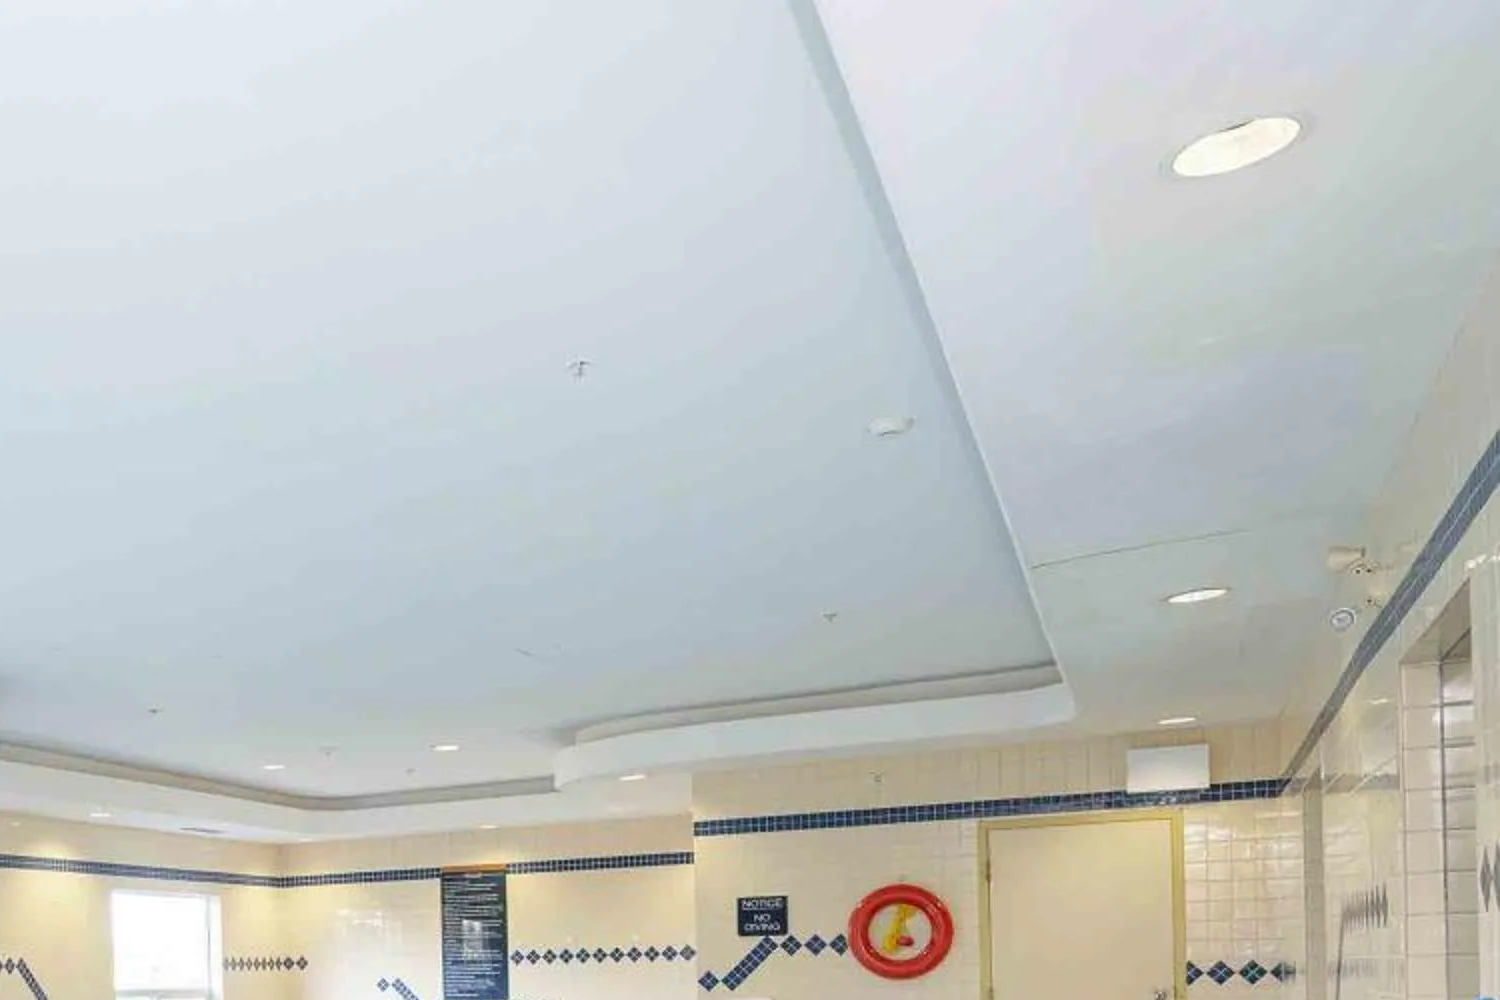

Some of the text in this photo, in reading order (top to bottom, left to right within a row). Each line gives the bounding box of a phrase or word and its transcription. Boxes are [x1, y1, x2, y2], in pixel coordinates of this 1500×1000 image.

[742, 897, 783, 909] NOTICE
[753, 913, 771, 923] NO
[743, 920, 781, 931] DIVING
